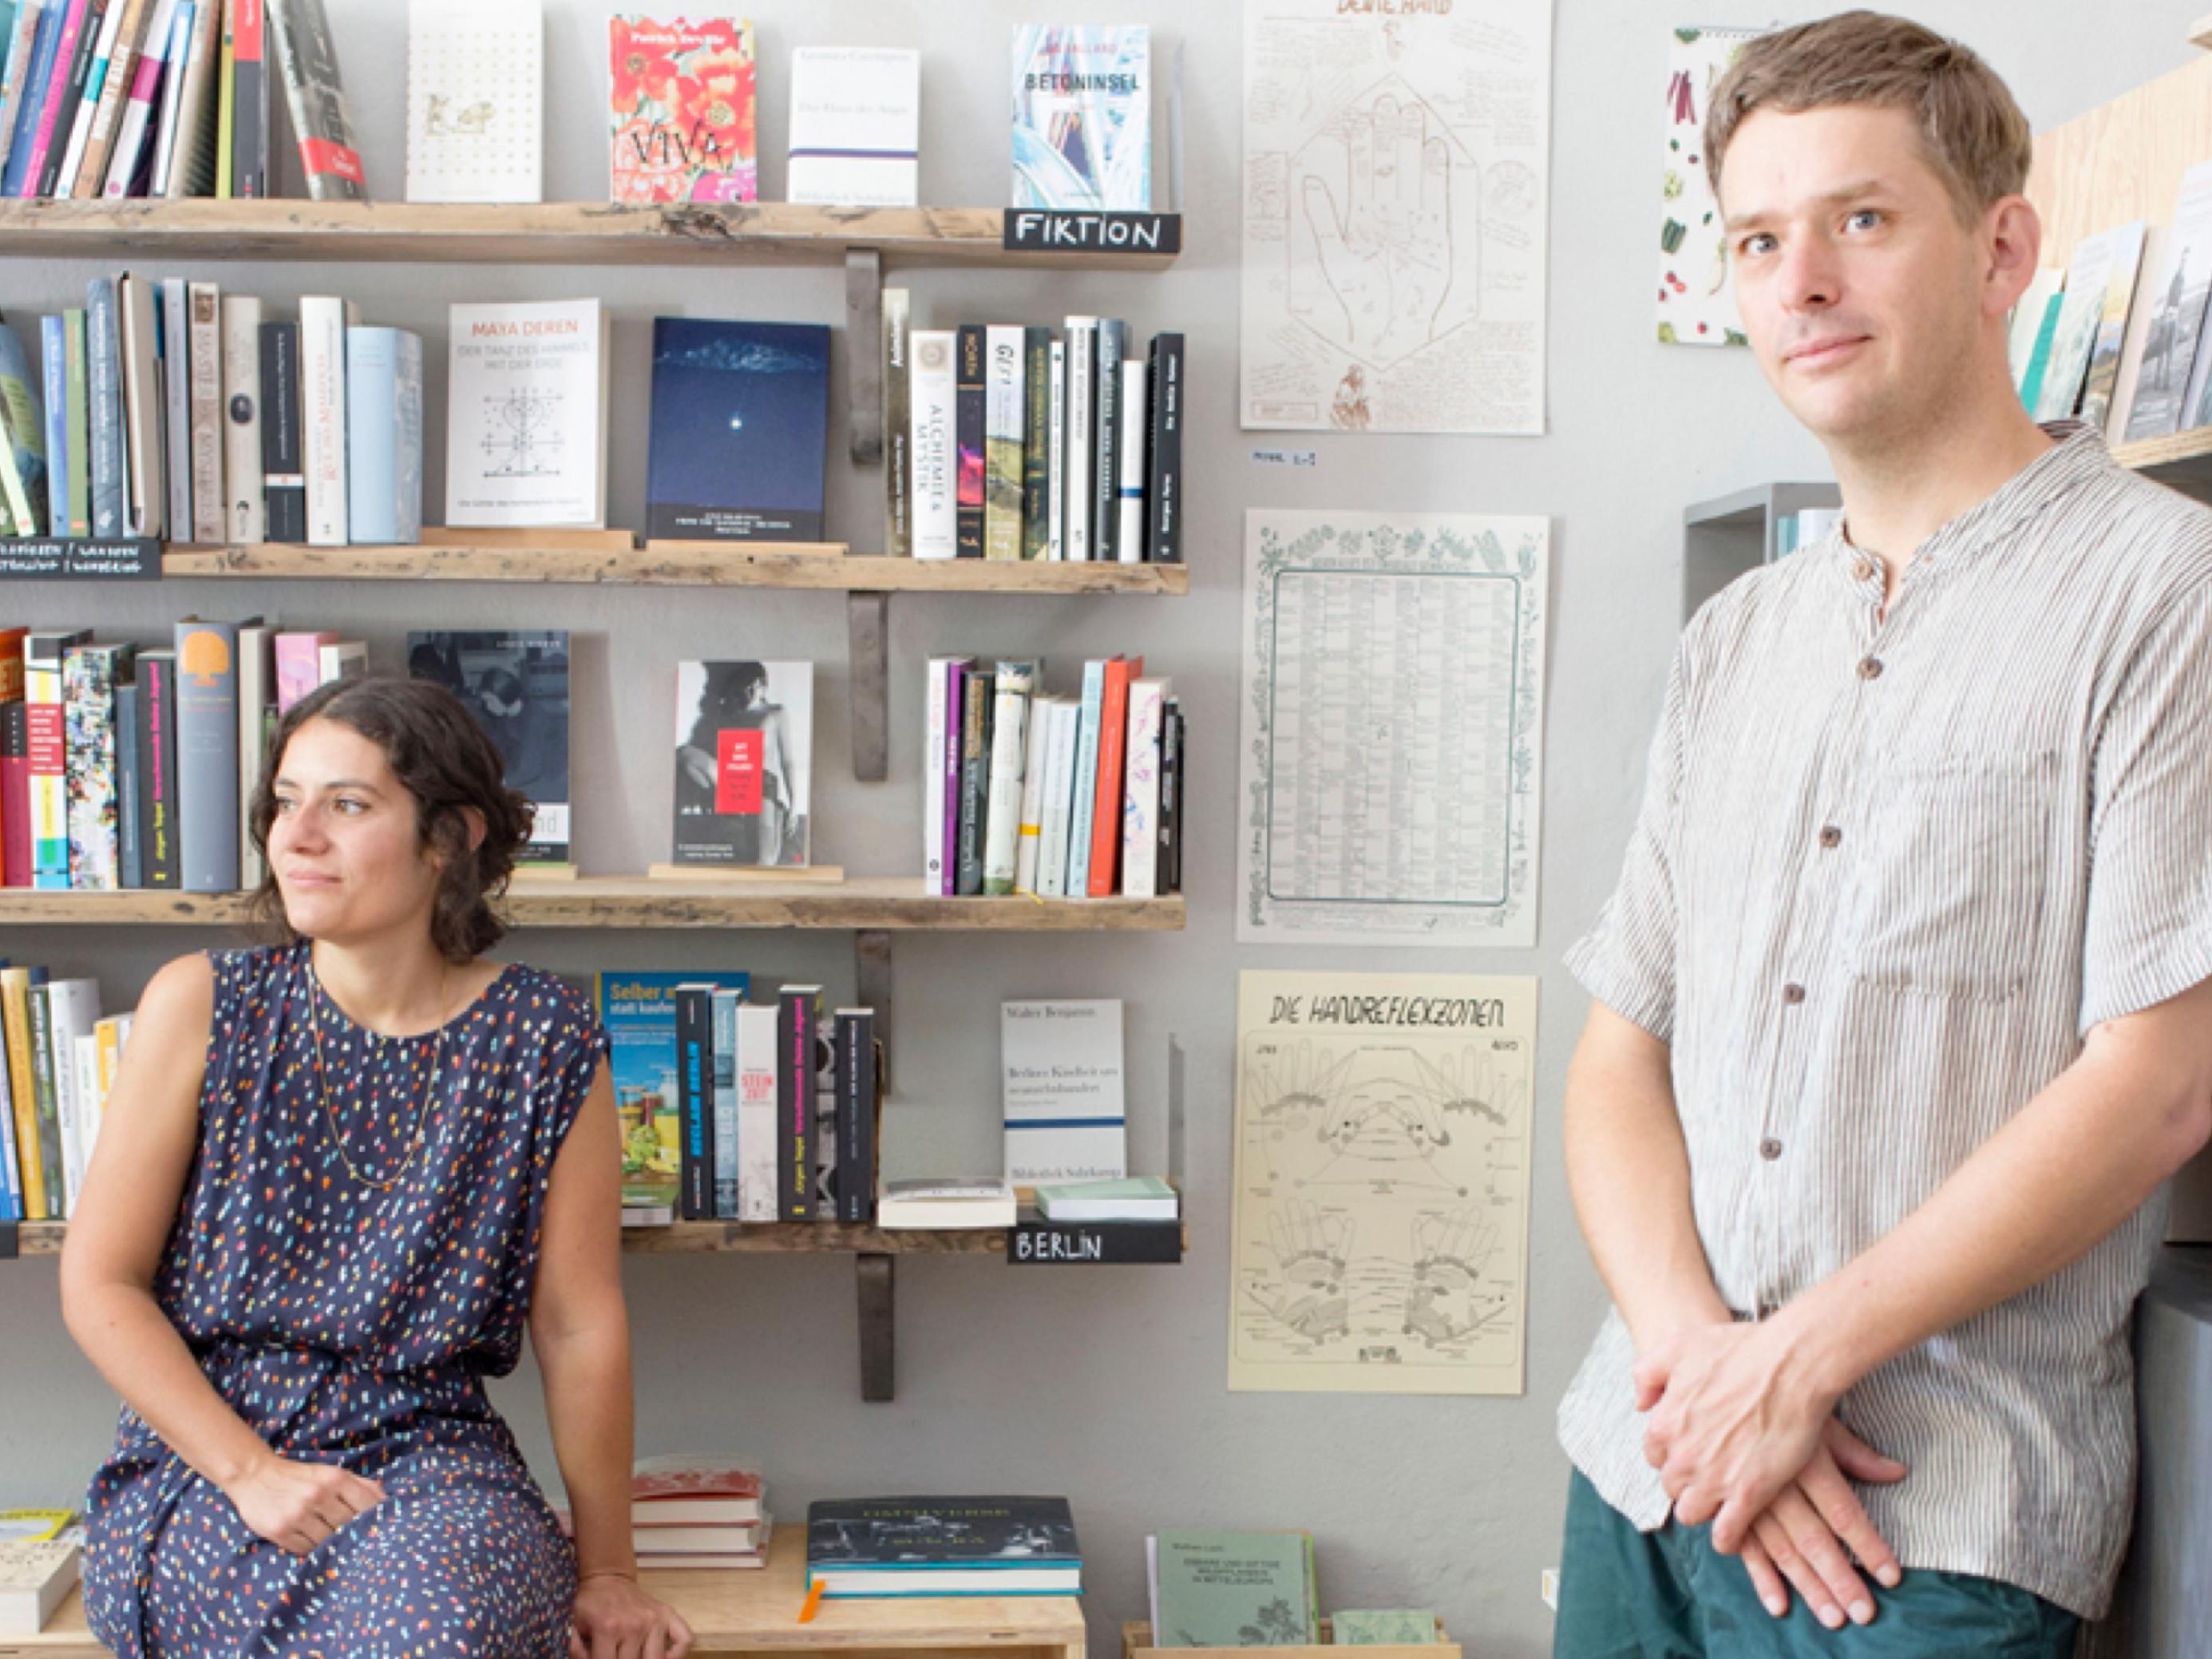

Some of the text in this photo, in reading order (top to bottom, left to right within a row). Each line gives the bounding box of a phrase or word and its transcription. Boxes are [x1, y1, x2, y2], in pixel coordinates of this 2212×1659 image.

[1025, 73, 1140, 90] BETONINSEL
[631, 118, 722, 164] VIVA
[1016, 213, 1161, 248] FIKTION
[473, 319, 580, 338] MAYA DEREN
[610, 983, 662, 1000] Selber
[1269, 996, 1505, 1027] DIE HANDREFLEXZONEN
[1015, 1229, 1102, 1260] BERLIN
